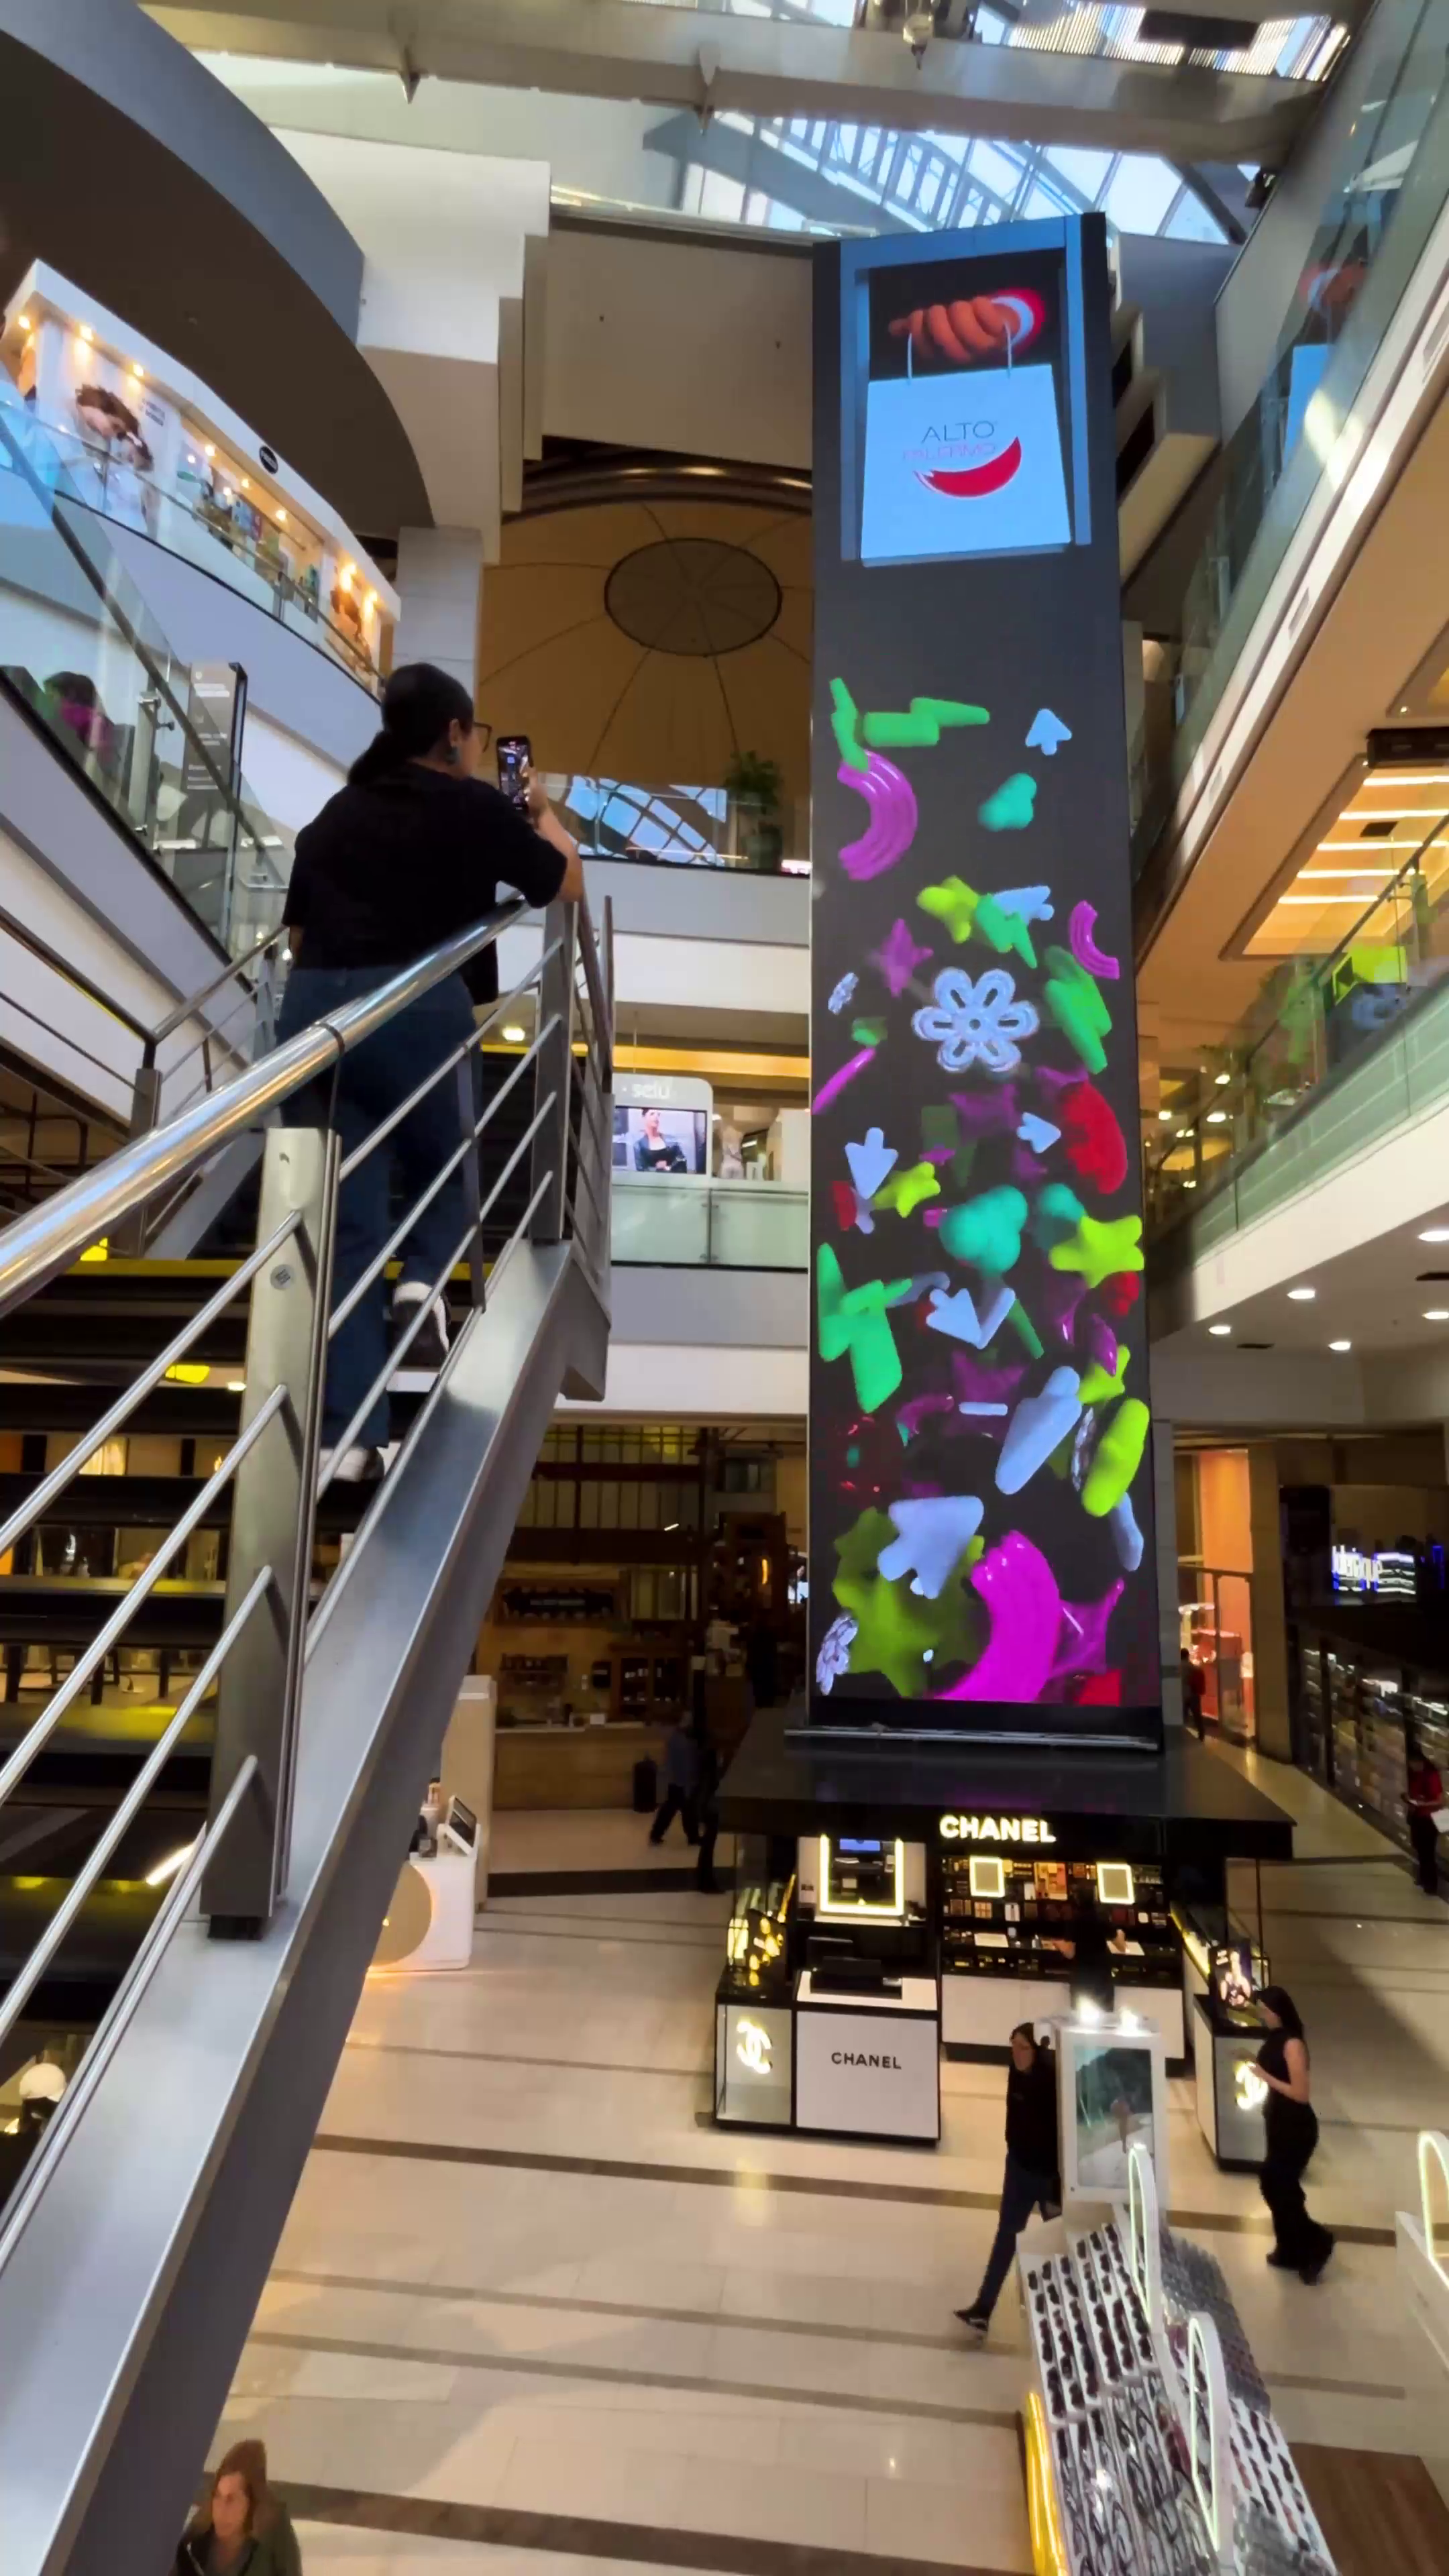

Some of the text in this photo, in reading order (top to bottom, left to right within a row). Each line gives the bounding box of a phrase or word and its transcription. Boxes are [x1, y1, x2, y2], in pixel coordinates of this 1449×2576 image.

[921, 421, 994, 443] ALTO
[940, 1814, 1057, 1843] CHANEL
[831, 2052, 902, 2070] CHANEL
